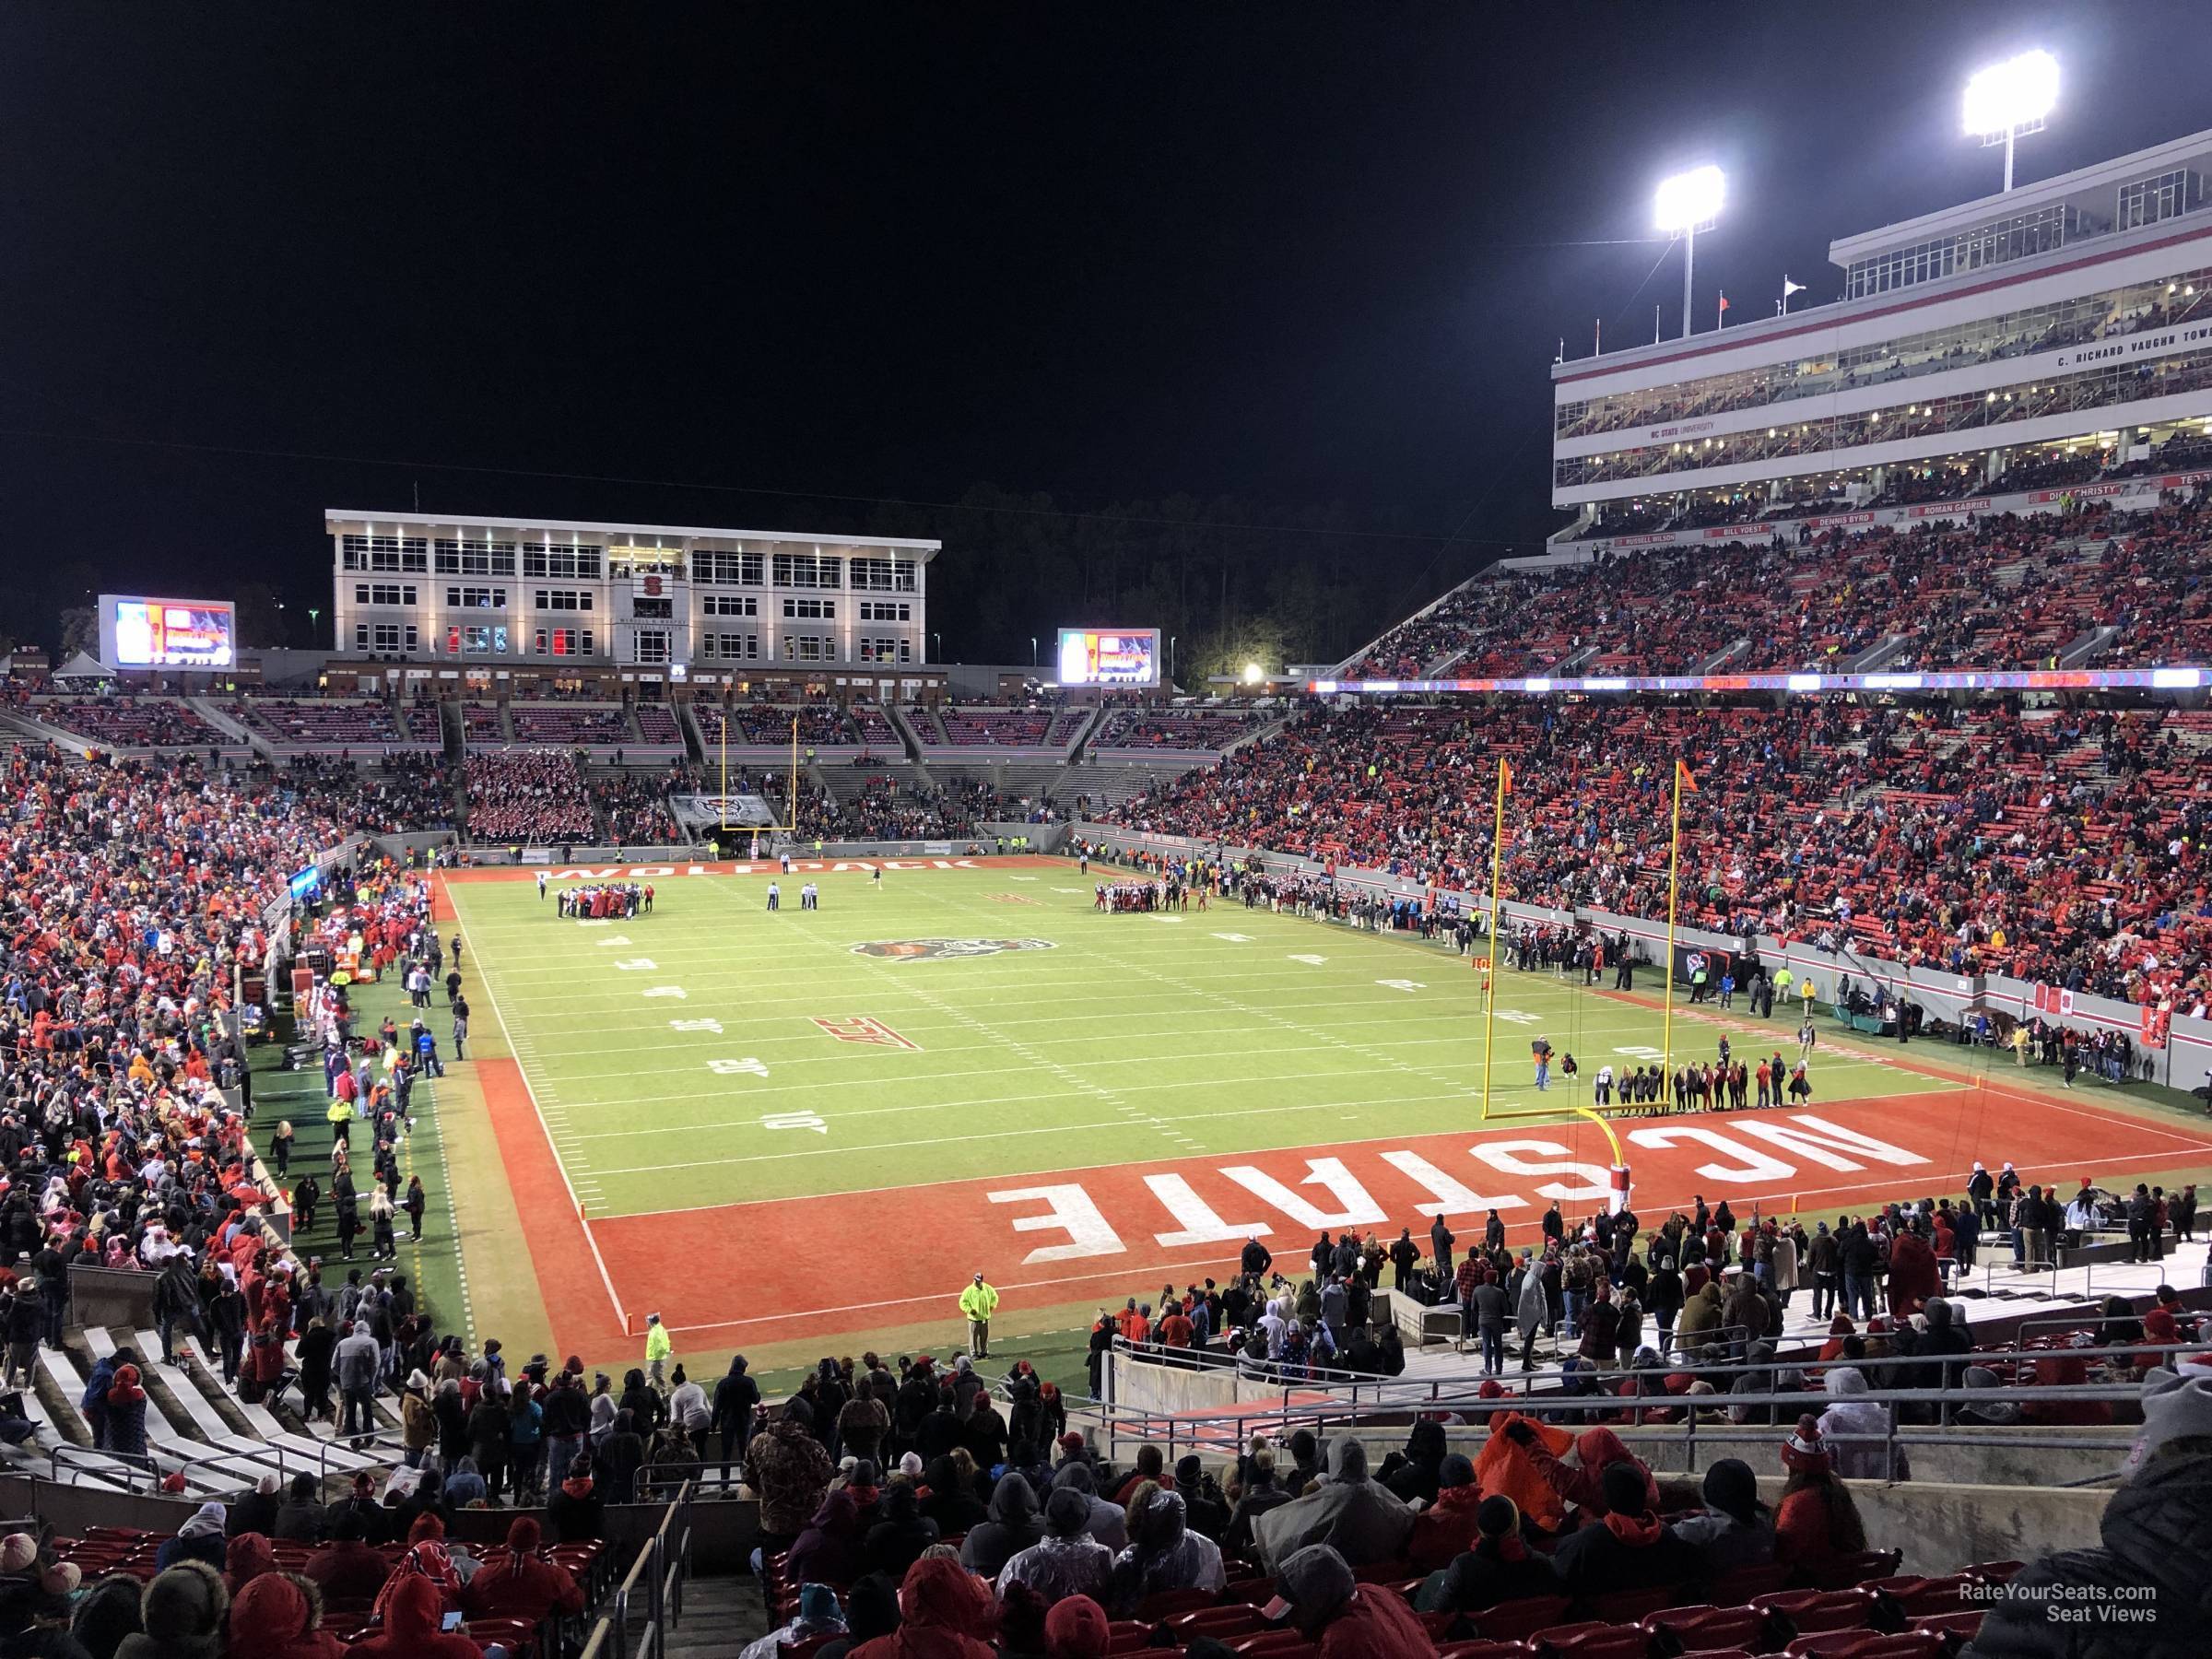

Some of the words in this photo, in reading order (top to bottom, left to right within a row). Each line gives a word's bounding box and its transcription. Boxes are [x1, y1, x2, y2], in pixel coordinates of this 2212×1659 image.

[2058, 357, 2069, 367] C.
[2076, 346, 2124, 363] RICHARD
[2131, 335, 2175, 352] VAUGHN
[1651, 430, 1659, 439] NC
[1661, 427, 1679, 438] STATE
[1680, 422, 1713, 434] UNIVERSITY
[1924, 504, 1953, 515] ROMAN
[1954, 500, 1990, 512] GABRIEL
[1819, 515, 1848, 526] DENNIS
[1849, 513, 1869, 524] BYRD
[1723, 527, 1739, 535] BILL
[1626, 536, 1652, 546] RUSSELL
[1652, 535, 1675, 544] WILSON
[535, 860, 981, 879] WOLFPACK
[759, 1110, 827, 1131] 10
[1627, 1114, 1934, 1183] NC
[987, 1139, 1635, 1265] STATE
